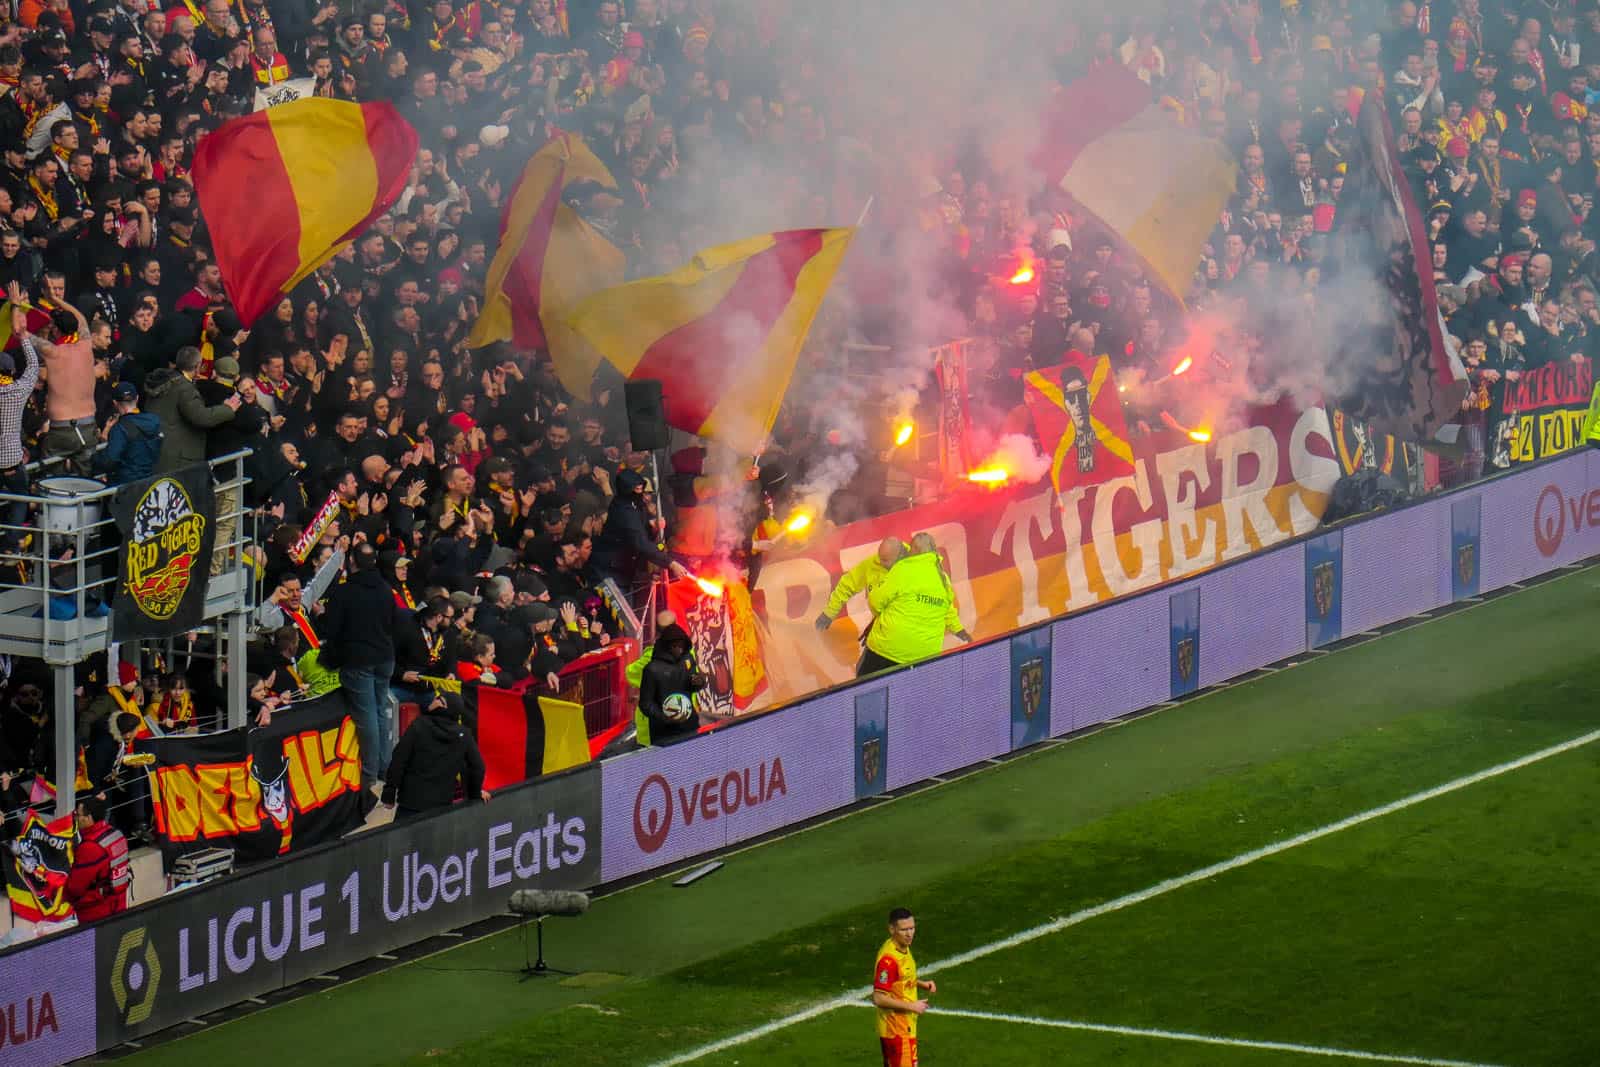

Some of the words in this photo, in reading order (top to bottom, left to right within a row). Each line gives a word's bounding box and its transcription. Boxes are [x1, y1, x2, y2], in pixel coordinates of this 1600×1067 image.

[160, 514, 204, 554] TIGERS
[990, 406, 1342, 625] TIGERS
[127, 540, 159, 589] RED
[678, 757, 787, 826] VEOLIA
[179, 881, 327, 993] LIGUE
[341, 871, 360, 934] 1
[382, 847, 479, 922] Uber
[487, 811, 587, 889] Eats
